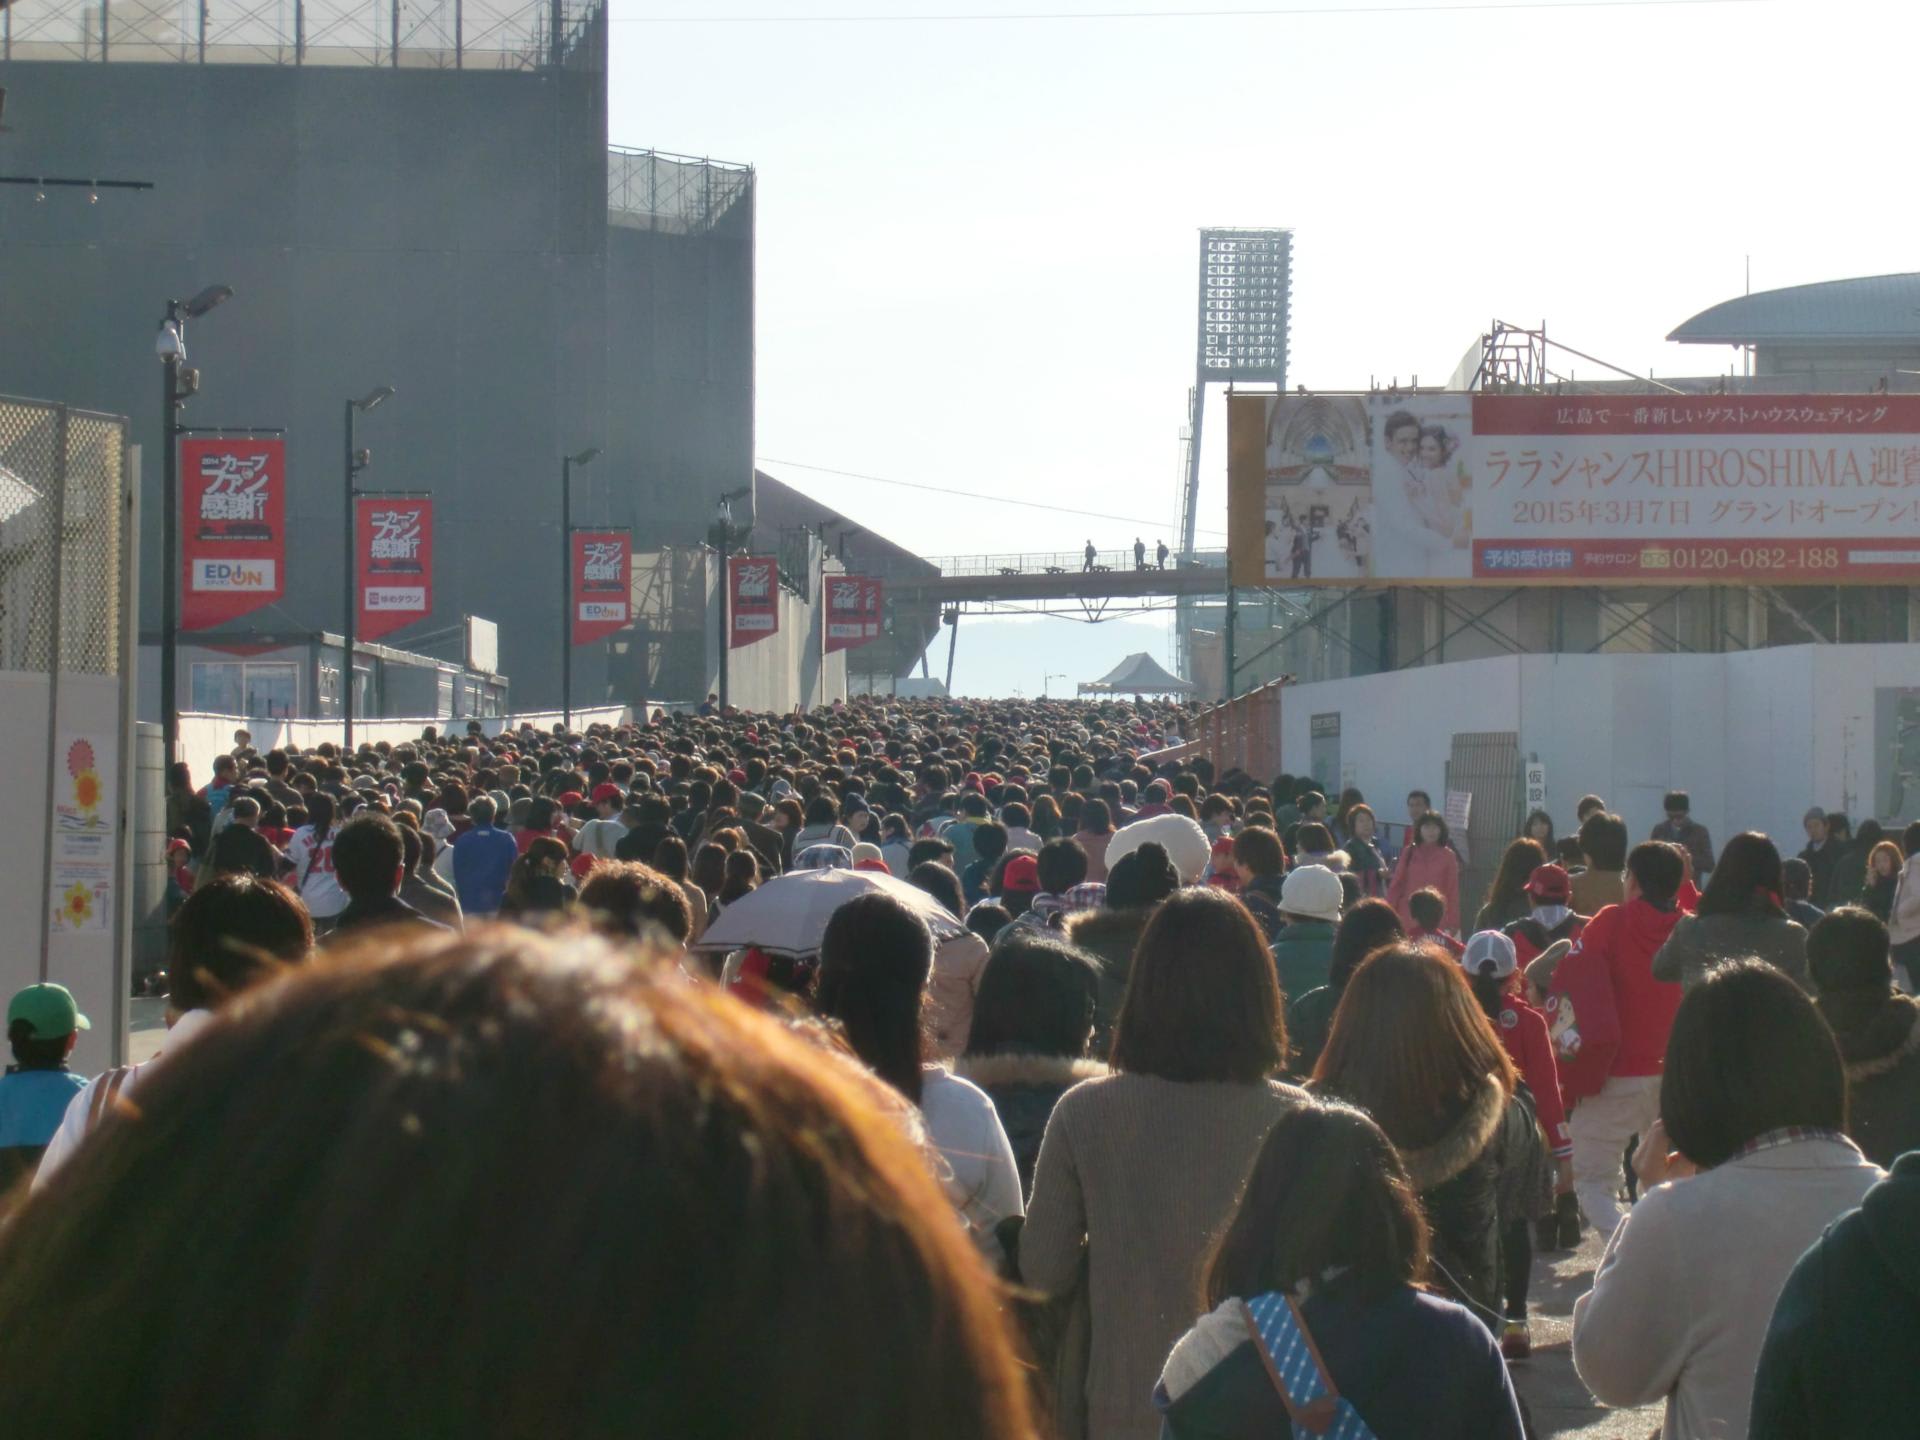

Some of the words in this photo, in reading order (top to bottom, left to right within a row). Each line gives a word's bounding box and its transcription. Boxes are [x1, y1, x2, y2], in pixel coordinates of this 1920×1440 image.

[1557, 406, 1888, 425] 広島で一番新しいゲストハウスウェディング
[221, 454, 268, 471] カープ
[1512, 500, 1690, 525] 2015年3月7日
[1484, 551, 1572, 568] 予約受付中
[1673, 548, 1838, 569] 0120-082-188
[204, 564, 262, 585] EDION
[1528, 769, 1544, 813] 仮設
